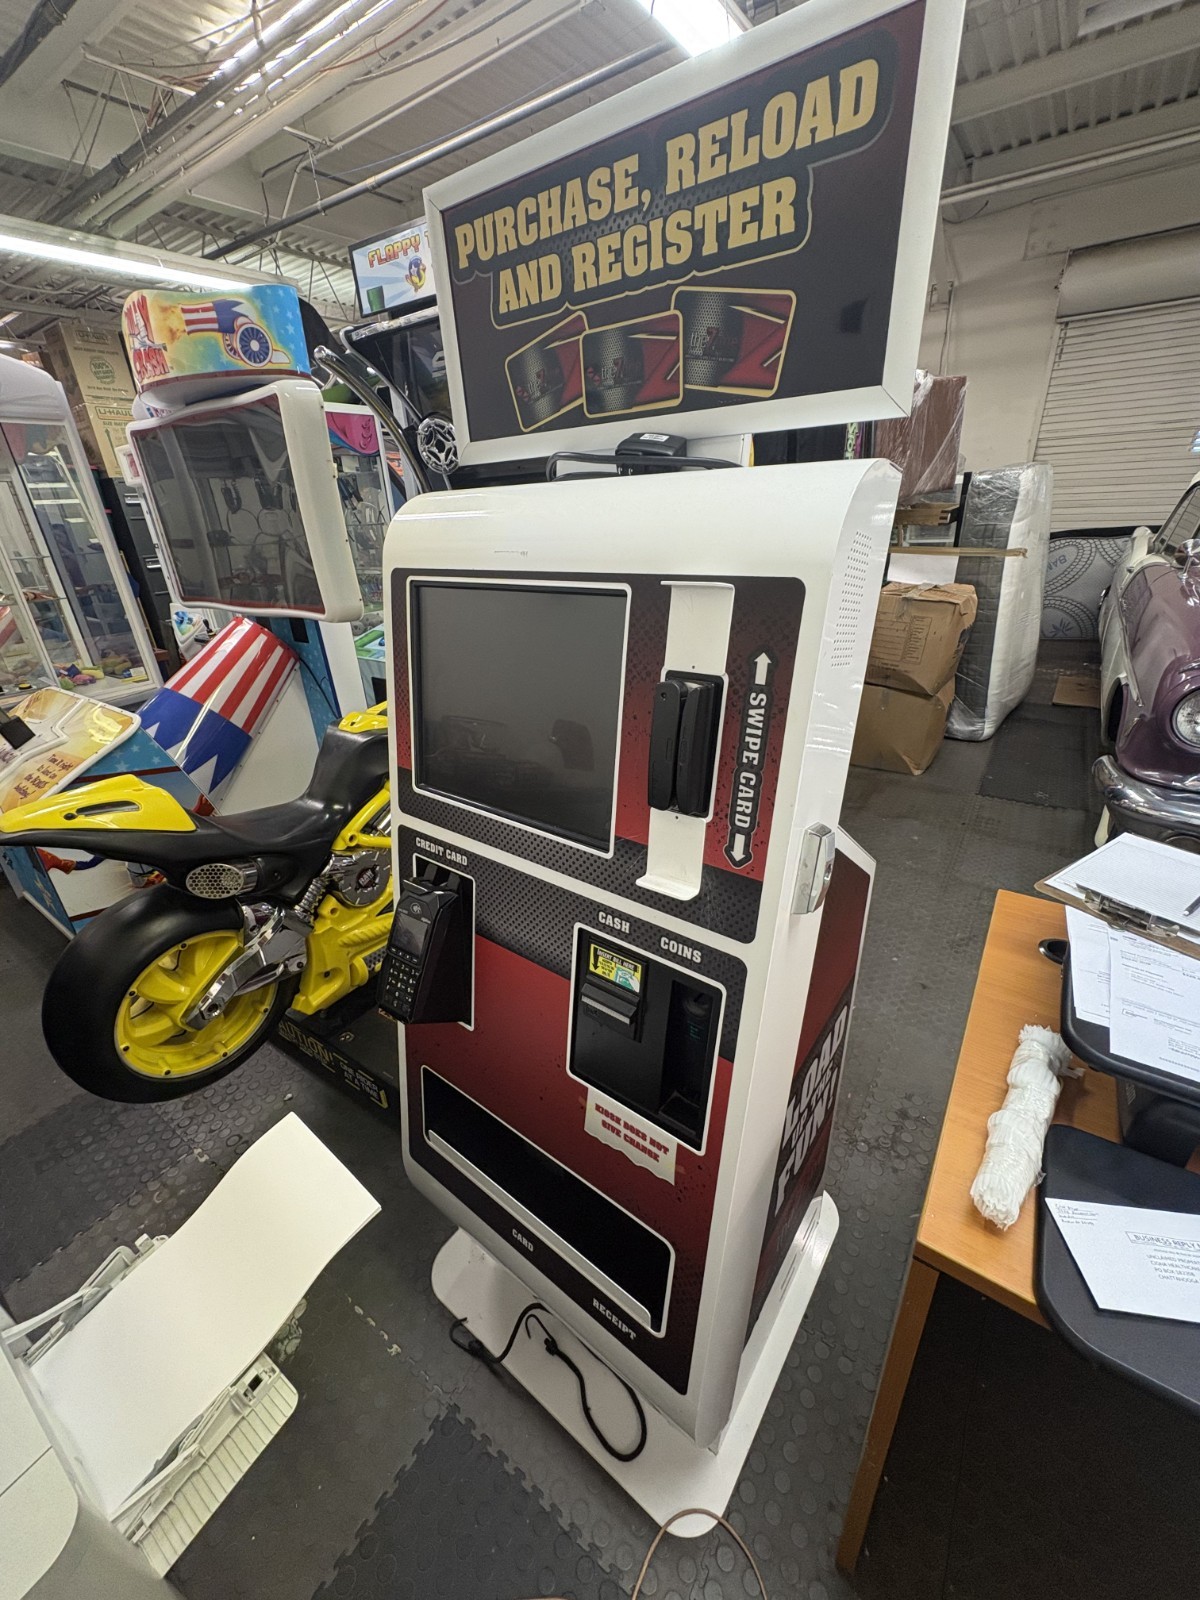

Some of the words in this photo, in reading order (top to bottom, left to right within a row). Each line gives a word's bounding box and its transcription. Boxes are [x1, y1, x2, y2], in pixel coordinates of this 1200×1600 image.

[455, 154, 651, 271] PURCHASE,
[665, 58, 880, 195] RELOAD
[368, 234, 421, 268] FLAPPY
[499, 253, 563, 316] AND
[572, 176, 797, 293] REGISTER
[98, 407, 132, 417] U-HAUL
[742, 692, 767, 766] SWIPE
[734, 771, 756, 829] CARD
[415, 836, 444, 857] CREDIT
[445, 849, 468, 866] CARD
[596, 948, 614, 961] INSERT
[598, 911, 631, 934] CASH
[660, 936, 702, 964] COINS
[355, 1072, 379, 1093] RIDER
[360, 1082, 380, 1100] TIME
[781, 1004, 848, 1151] LOAD
[594, 1103, 622, 1127] KIOSK
[622, 1120, 648, 1143] DOES
[649, 1136, 670, 1156] NOT
[601, 1119, 622, 1138] GIVE
[623, 1133, 660, 1164] CHANGE
[774, 1066, 839, 1218] FUN!
[791, 1106, 808, 1149] UP
[511, 1228, 535, 1253] CARD
[1133, 1234, 1172, 1246] BUSINESS
[1172, 1240, 1196, 1249] REPLY
[592, 1297, 637, 1341] RECEIPT
